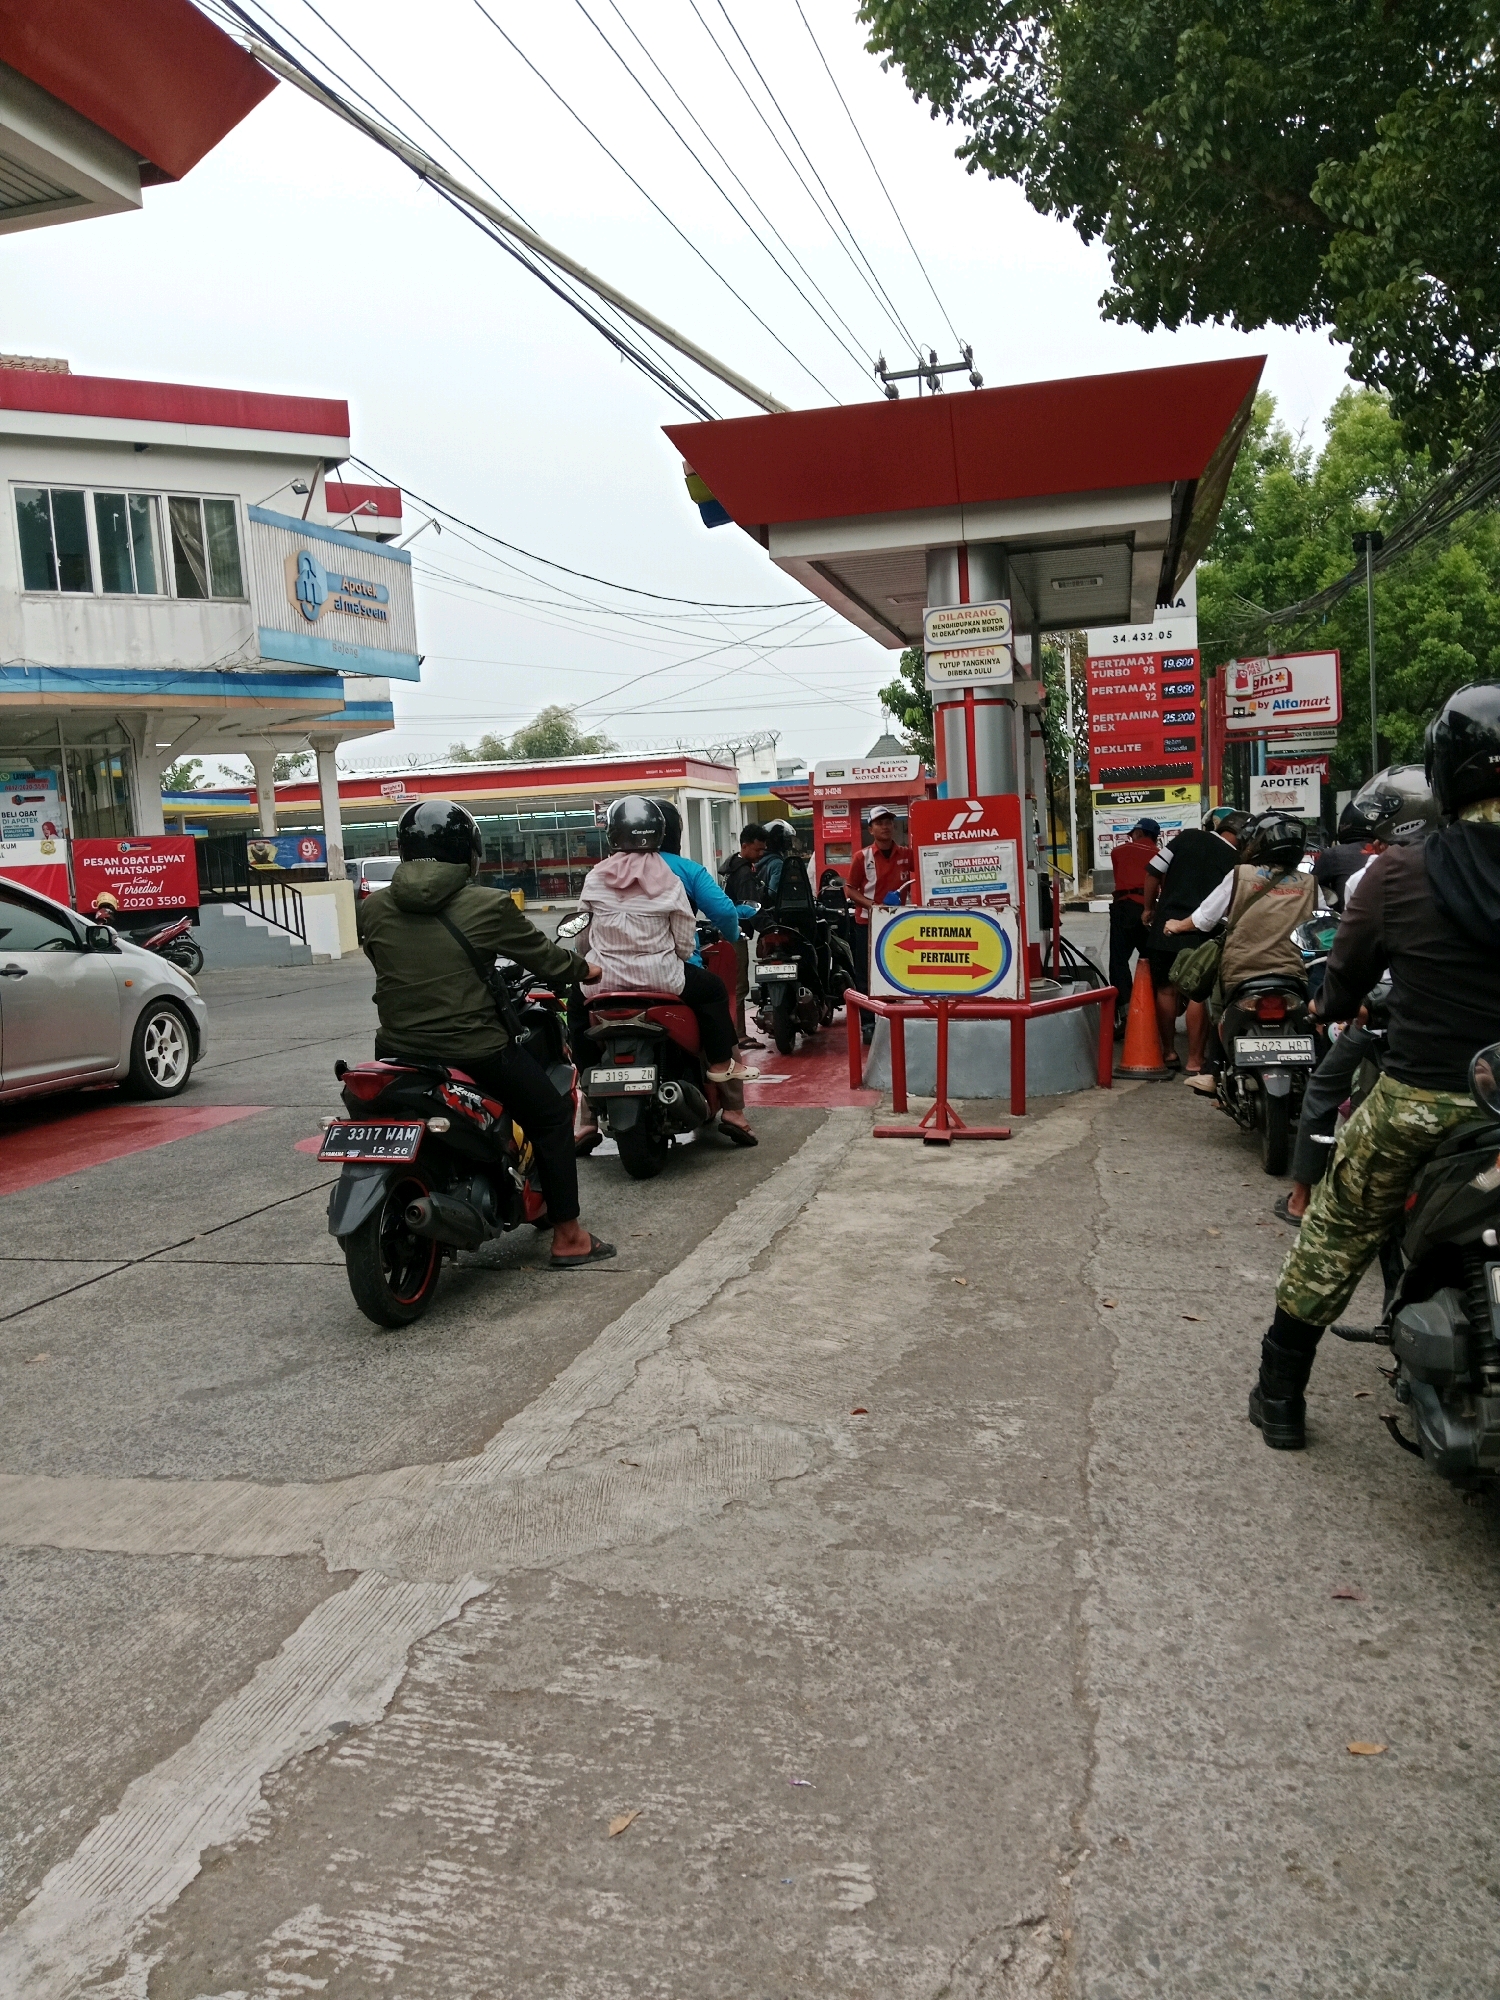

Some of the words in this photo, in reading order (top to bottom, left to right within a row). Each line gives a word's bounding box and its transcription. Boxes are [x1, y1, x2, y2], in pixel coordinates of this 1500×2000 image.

[341, 577, 378, 599] Apotek
[938, 608, 997, 622] DILARANG
[932, 620, 981, 630] MENGHIDUPKAN
[982, 617, 1003, 626] MOTOR
[940, 630, 958, 638] DEKAT
[960, 627, 981, 636] POMPA
[982, 625, 1005, 633] BENSIN
[1112, 630, 1173, 643] 34.432.05
[332, 642, 359, 658] Bojong
[943, 647, 995, 660] PUNTEN
[938, 661, 960, 670] TUTUP
[962, 658, 1001, 667] TANGKINYA
[1091, 656, 1154, 669] PERTAMAX
[974, 667, 992, 675] DULU
[1091, 668, 1130, 679] TURBO
[1143, 666, 1155, 675] 98
[1091, 682, 1156, 696] PERTAMAX
[1145, 693, 1157, 701] 92
[1257, 701, 1269, 710] by
[1272, 696, 1330, 710] Alfamart
[1092, 710, 1159, 723] PERTAMINA
[1093, 723, 1115, 733] DEX
[1094, 743, 1142, 754] DEXLITE
[852, 765, 908, 775] Enduro
[1285, 762, 1327, 776] APOTEK
[1260, 777, 1309, 788] APOTEK
[1117, 795, 1143, 804] CCTV
[18, 810, 38, 818] OBAT
[11, 817, 39, 825] APOTEK
[1395, 821, 1420, 833] INK
[933, 828, 999, 841] PERTAMINA
[83, 857, 119, 867] PESAN
[121, 856, 150, 865] OBAT
[152, 854, 186, 864] LEWAT
[938, 860, 953, 868] TIPS
[953, 859, 971, 867] BBM
[971, 857, 999, 866] HEMAT
[934, 868, 951, 876] TAPI
[952, 865, 1002, 875] PERJALANAN
[942, 875, 965, 884] TETAP
[965, 873, 997, 882] NIKMAT
[111, 880, 164, 895] Tersedia!
[123, 897, 154, 908] 2020
[157, 895, 187, 906] 3590
[920, 926, 972, 938] PERTAMAX
[920, 952, 970, 963] PERTALITE
[1254, 1041, 1282, 1052] 3623
[593, 1072, 599, 1083] F
[641, 1069, 653, 1080] ZN
[330, 1128, 341, 1140] F
[347, 1127, 383, 1141] 3317
[385, 1127, 417, 1142] WAM
